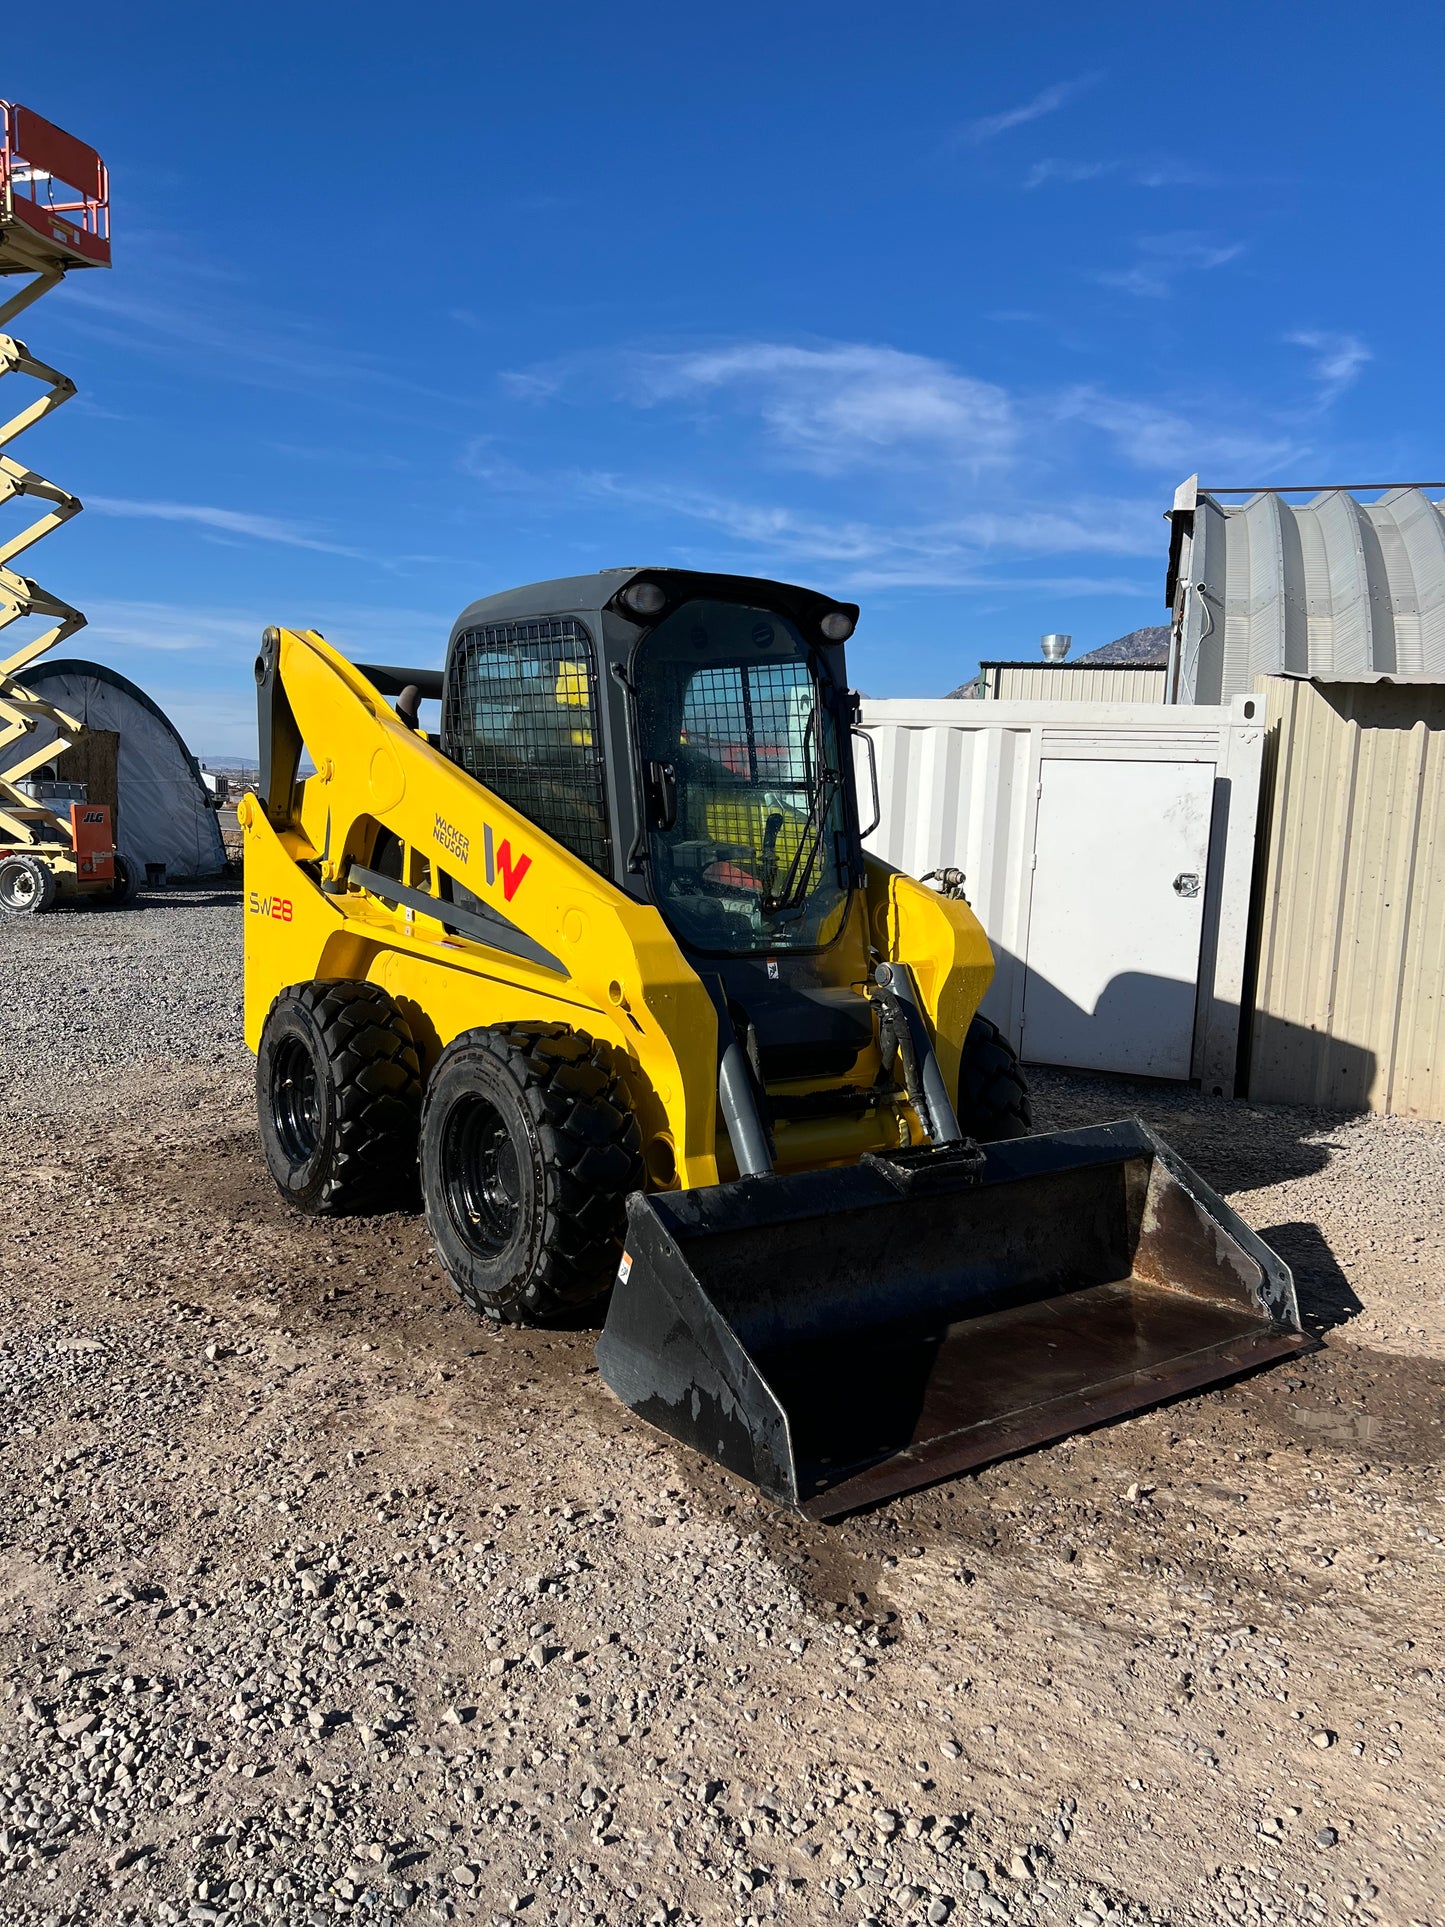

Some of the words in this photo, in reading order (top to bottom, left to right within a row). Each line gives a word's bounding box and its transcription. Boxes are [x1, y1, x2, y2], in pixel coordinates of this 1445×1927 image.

[83, 812, 103, 824] JLG
[435, 812, 470, 852] WACKER
[433, 826, 469, 865] NEUSON
[250, 892, 292, 923] SW28
